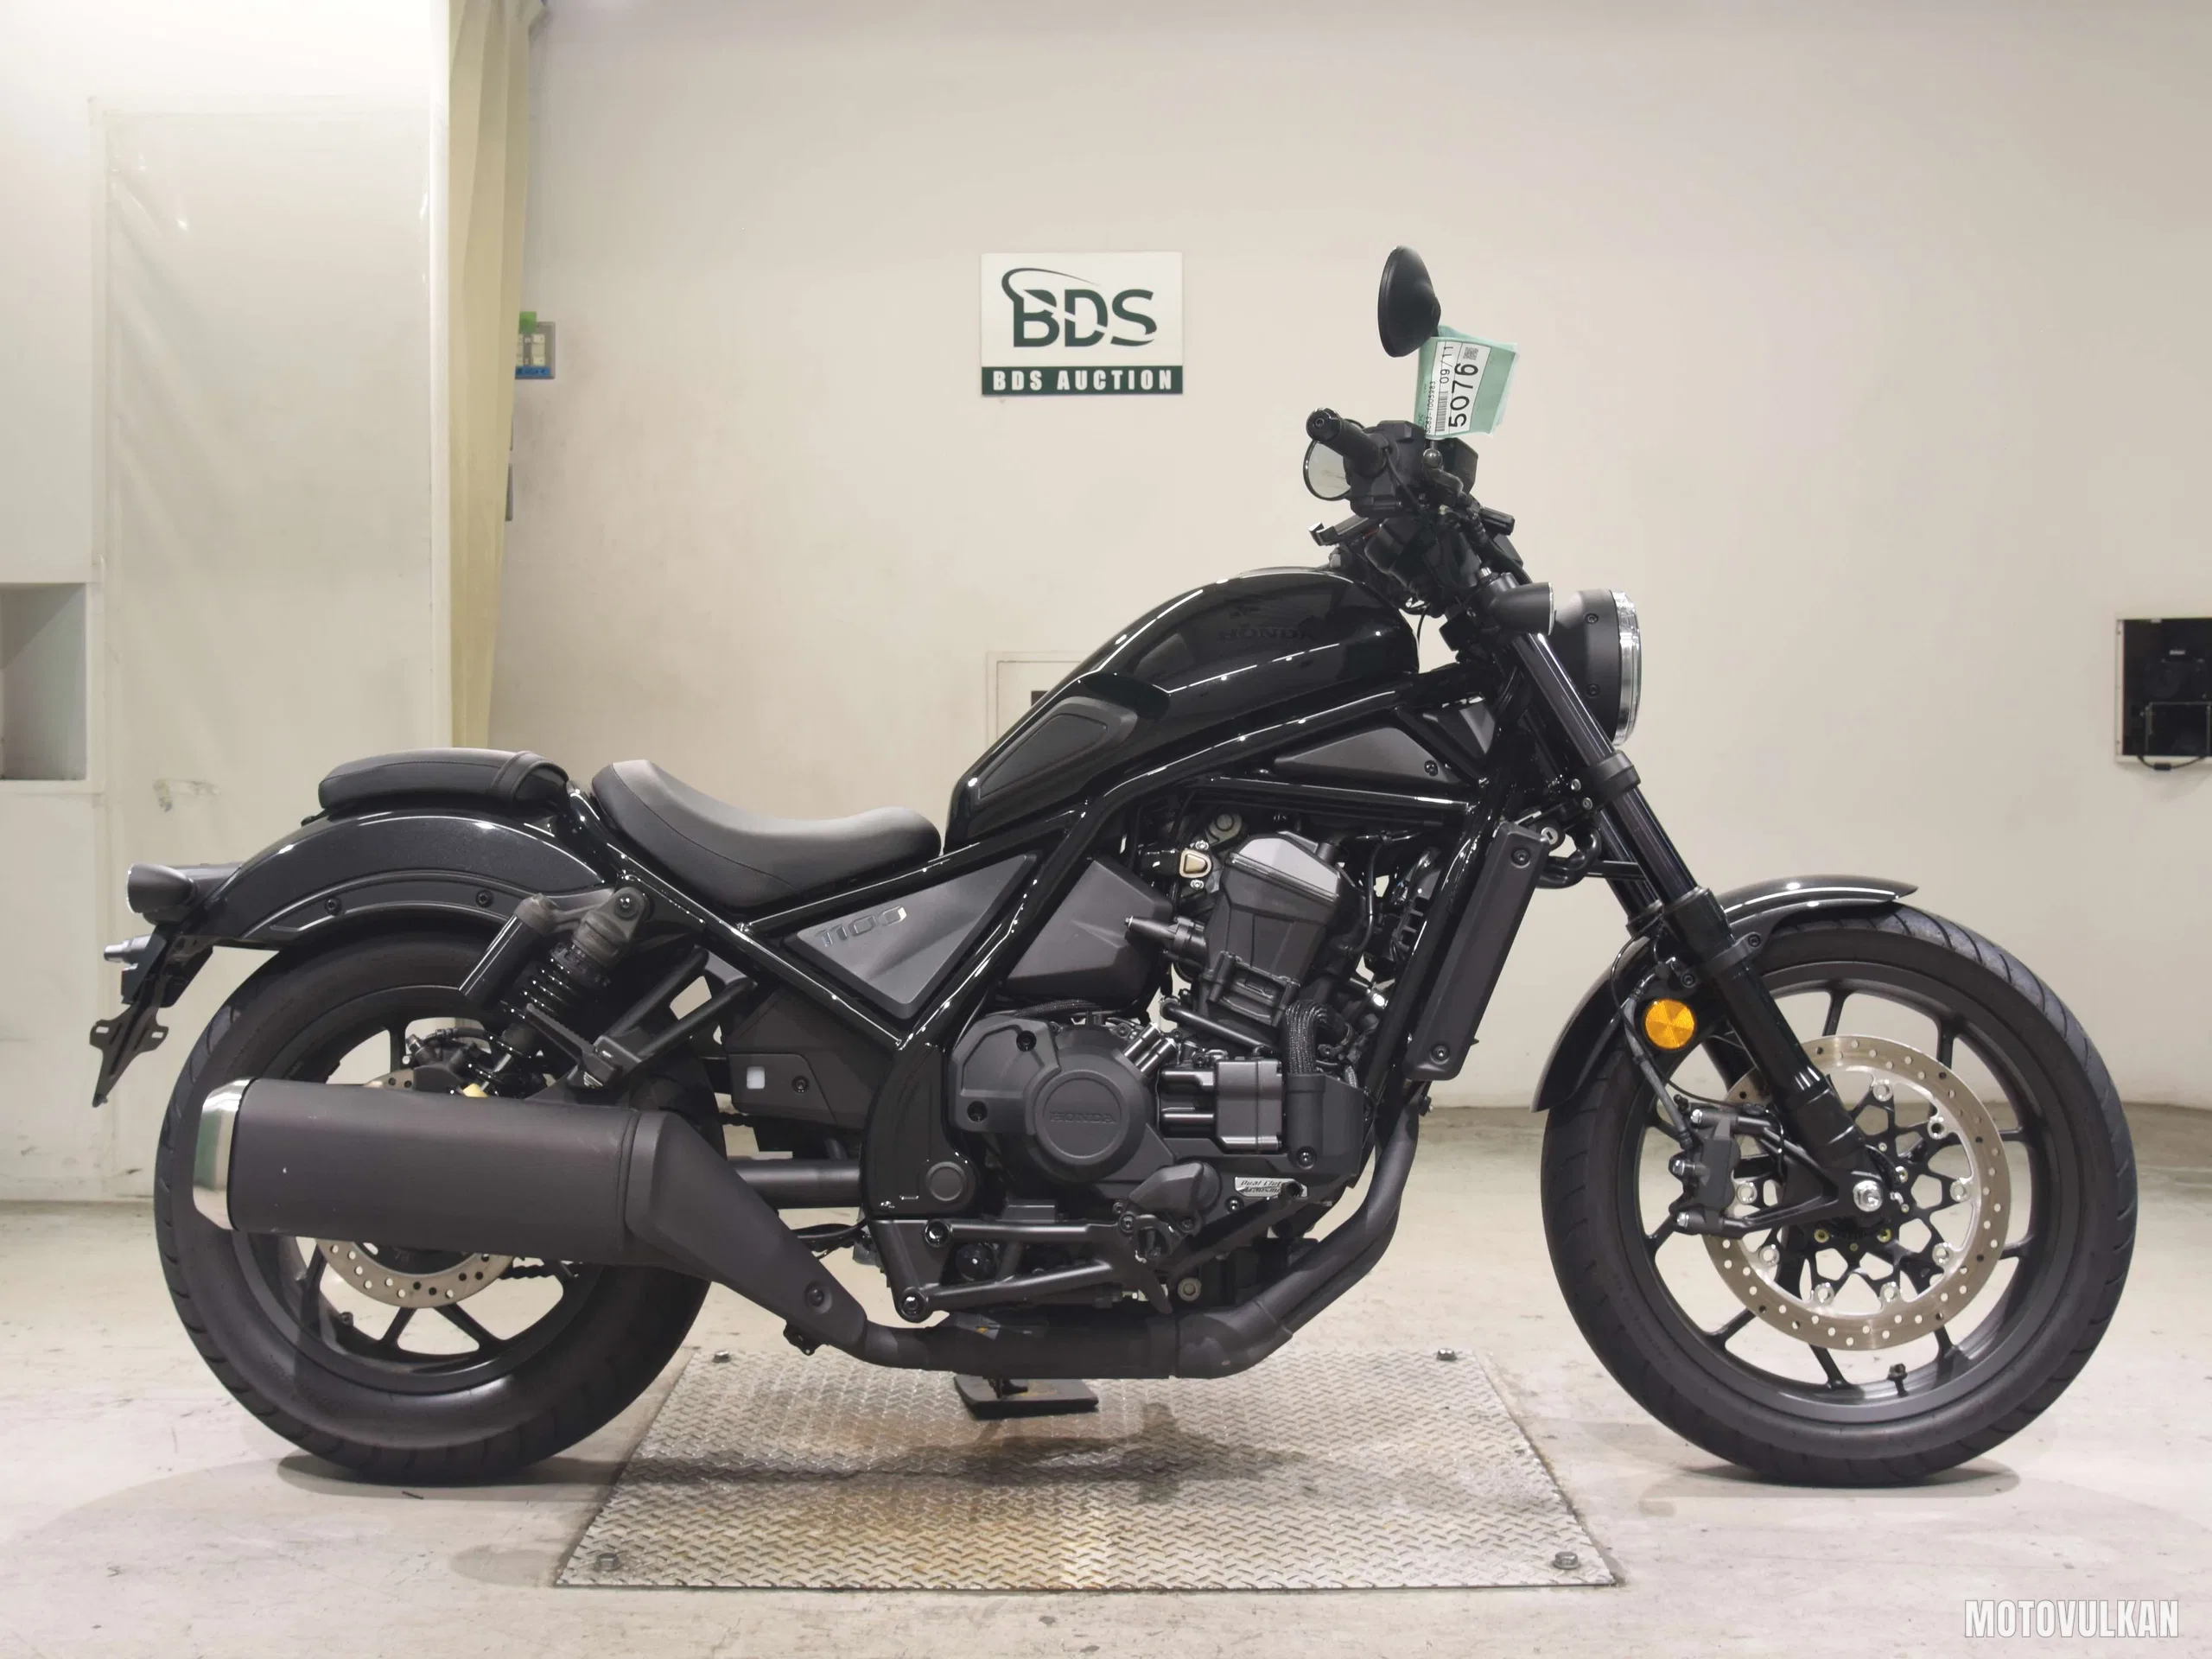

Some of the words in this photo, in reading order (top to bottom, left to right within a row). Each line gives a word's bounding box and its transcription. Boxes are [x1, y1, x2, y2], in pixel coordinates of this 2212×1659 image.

[1001, 268, 1158, 347] BDS
[993, 370, 1043, 391] BDS
[1057, 370, 1172, 390] AUCTION
[1440, 346, 1454, 384] 09/11
[1448, 363, 1478, 427] 5076
[1049, 1111, 1117, 1123] HONDA
